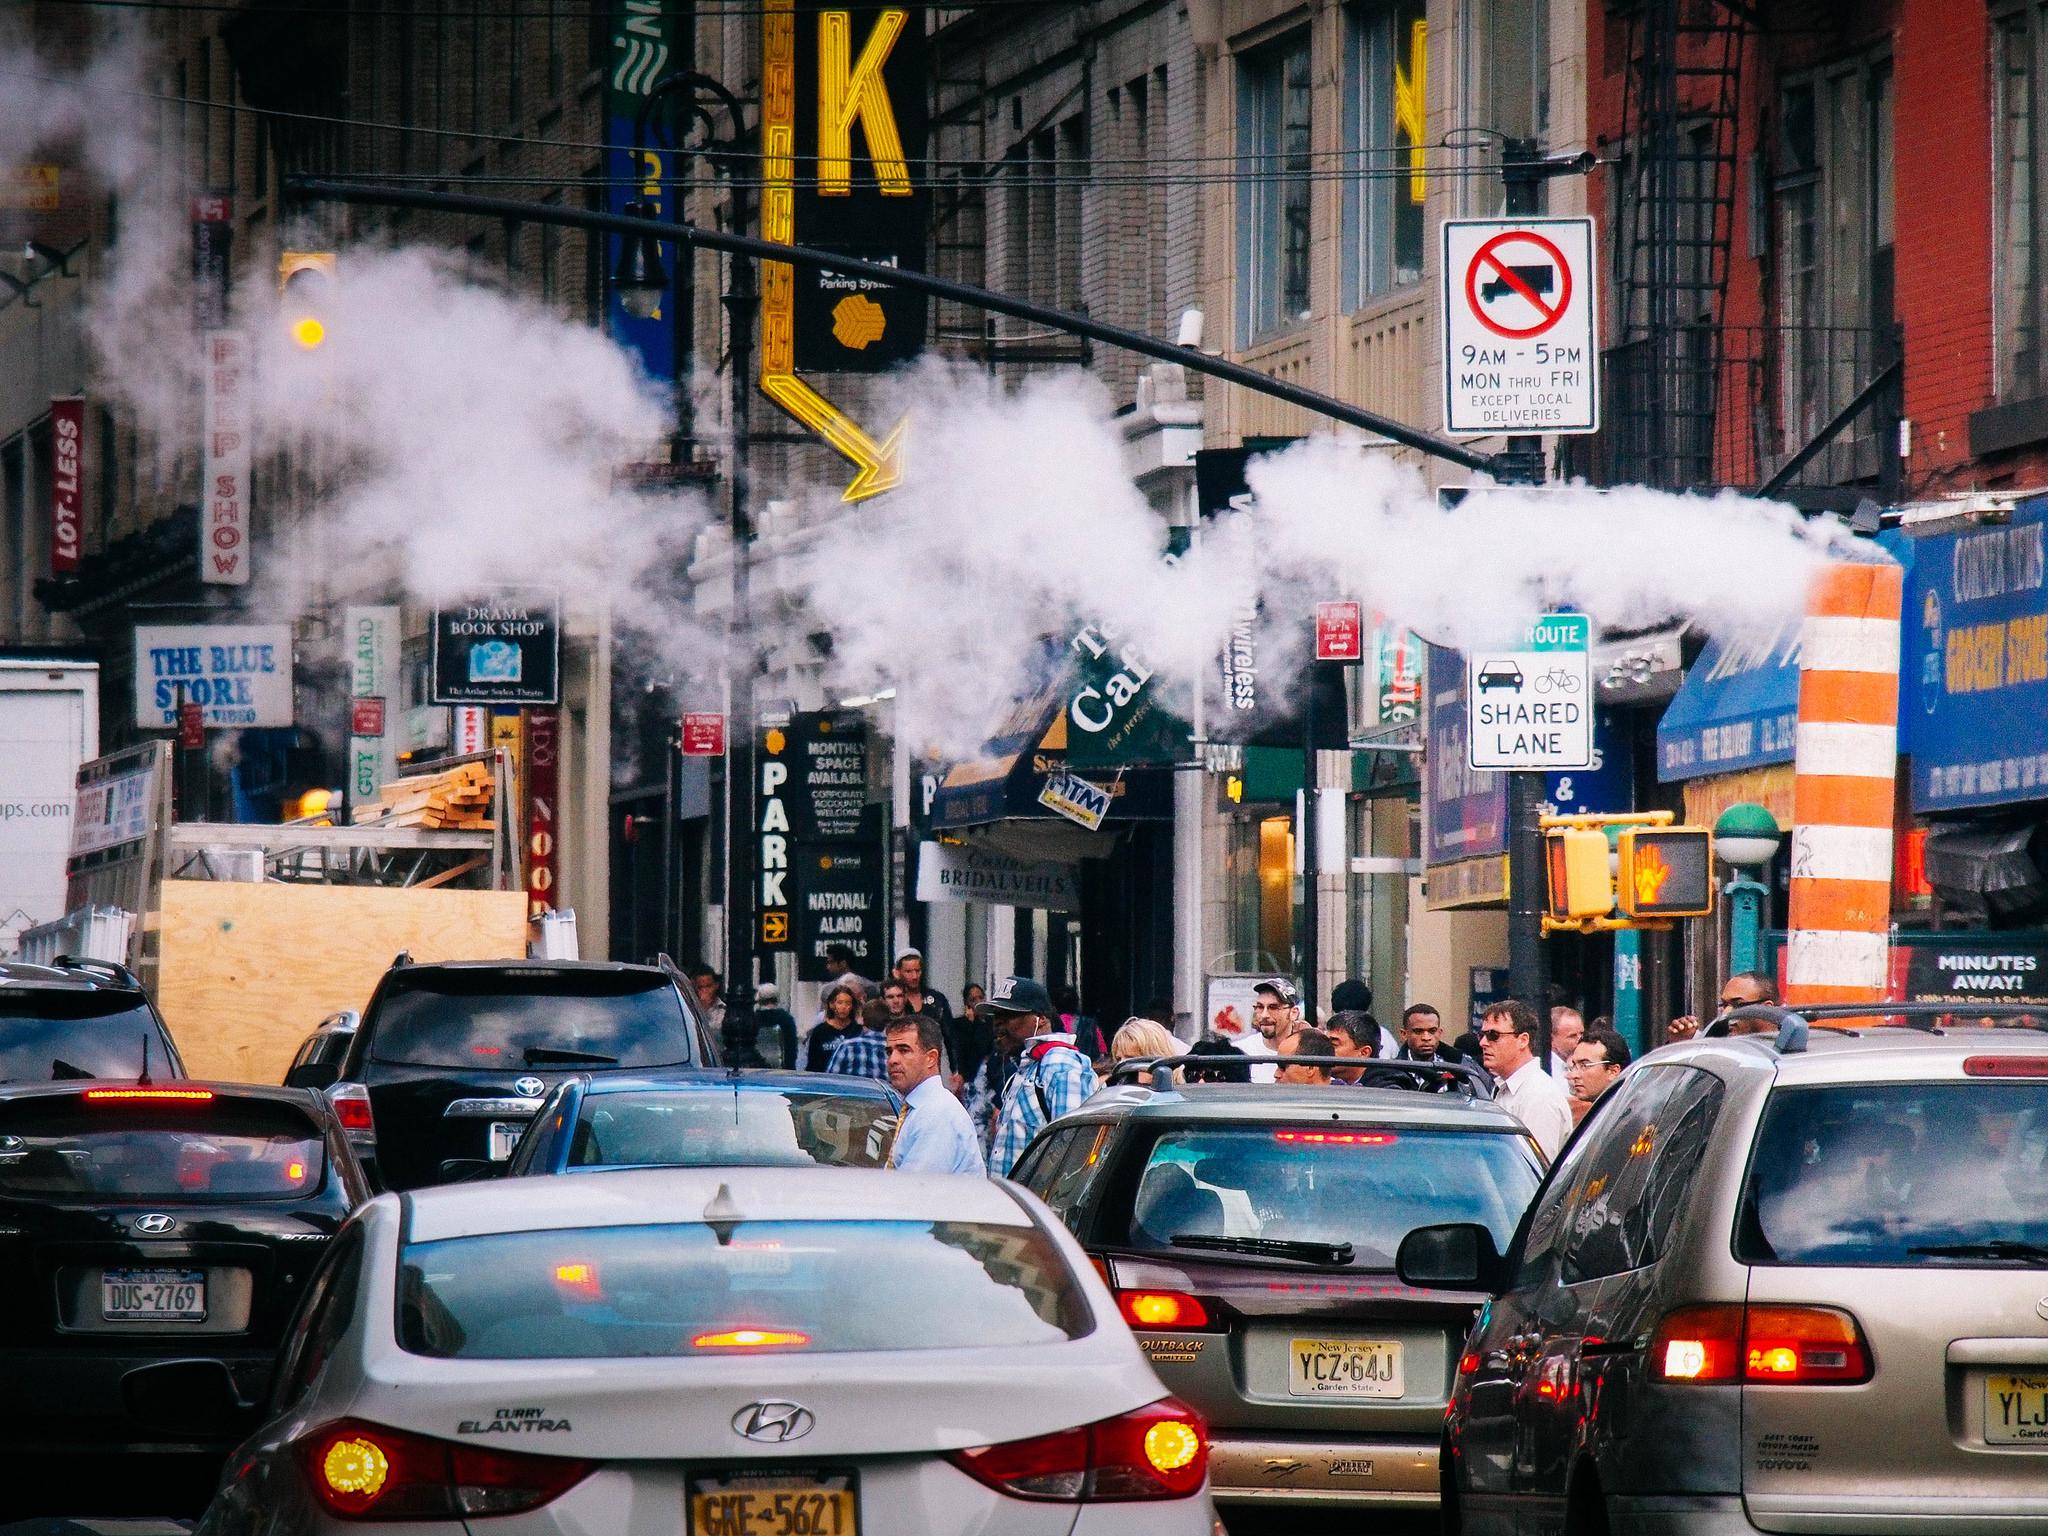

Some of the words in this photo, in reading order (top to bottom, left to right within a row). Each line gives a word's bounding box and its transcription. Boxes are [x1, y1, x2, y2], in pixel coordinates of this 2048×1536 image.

[820, 279, 857, 291] Parking
[1462, 344, 1506, 366] 9AM
[1536, 343, 1581, 365] 5PM
[1461, 373, 1501, 390] MON
[1509, 377, 1541, 389] THRU
[1551, 371, 1580, 387] FRI
[1471, 394, 1520, 407] EXCEPT
[1529, 393, 1573, 405] LOCAL
[1483, 409, 1561, 423] DELIVERIES
[213, 475, 241, 576] SHOW
[467, 607, 529, 621] DRAMA
[450, 621, 497, 636] BOOK
[501, 621, 545, 636] SHOP
[1524, 625, 1579, 644] ROUTE
[150, 647, 203, 676] THE
[210, 644, 275, 673] BLUE
[155, 677, 253, 708] STORE
[1071, 642, 1154, 733] Caf
[212, 709, 256, 723] VIDEO
[1480, 703, 1580, 725] SHARED
[807, 742, 865, 755] MONTHLY
[1497, 733, 1562, 754] LANE
[815, 757, 861, 770] SPACE
[357, 752, 374, 796] GUY
[807, 771, 865, 785] AVAILABL
[811, 790, 865, 799] CORPORATE
[1050, 772, 1106, 815] ATM
[0, 802, 69, 820] ps.com
[814, 800, 864, 808] ACCOUNTS
[815, 809, 861, 817] WELCOME
[762, 761, 789, 907] PARK
[833, 856, 861, 866] Central
[940, 869, 1005, 890] BRIDAL
[820, 915, 862, 933] ALAMO
[1938, 955, 2037, 972] MINUTES
[1952, 974, 2023, 990] AWAY!
[1141, 1339, 1204, 1351] OUTBACK
[1318, 1342, 1342, 1353] New
[1343, 1342, 1375, 1354] Jersey
[1152, 1354, 1196, 1362] LIMITED
[1317, 1382, 1349, 1392] Garden
[1351, 1383, 1375, 1393] State
[2021, 1377, 2048, 1390] New
[495, 1407, 545, 1419] CURRY
[456, 1420, 572, 1435] ELANTRA
[1756, 1459, 1812, 1471] TOYOTA
